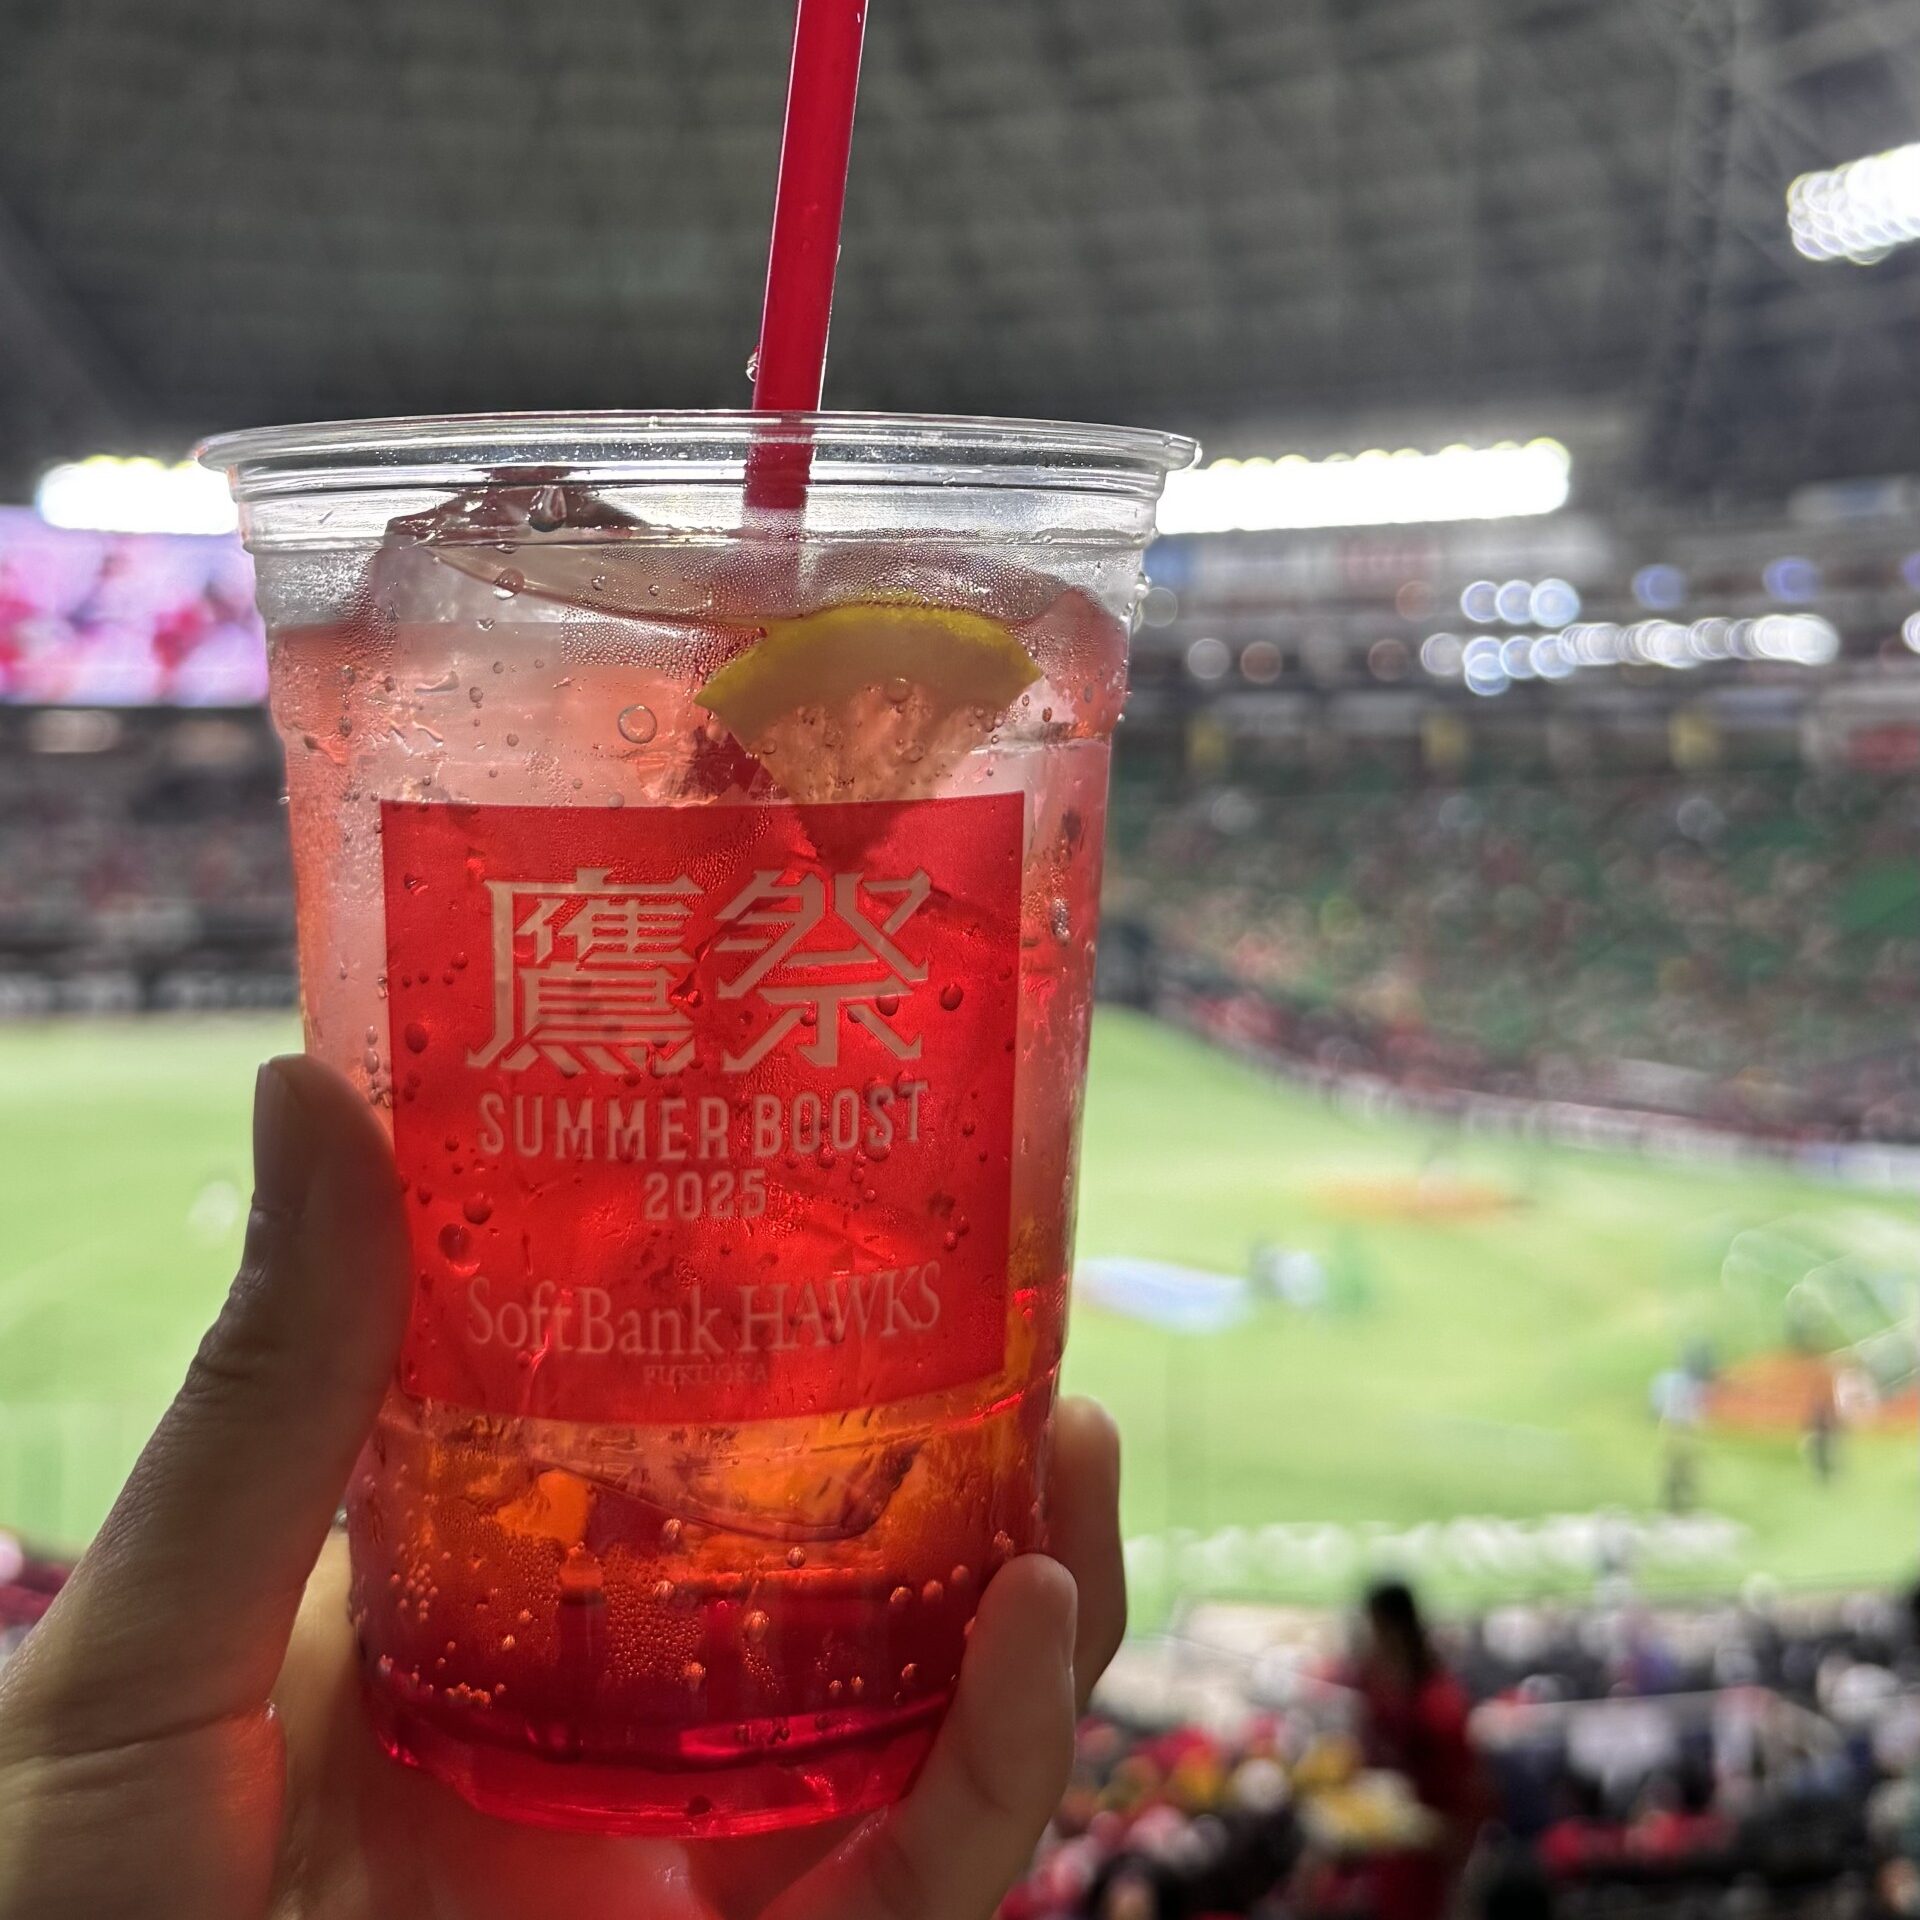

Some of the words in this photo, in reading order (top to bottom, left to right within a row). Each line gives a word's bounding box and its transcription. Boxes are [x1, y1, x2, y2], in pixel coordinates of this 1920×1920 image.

[465, 866, 934, 1077] 鷹祭
[479, 1091, 731, 1162] SUMMER
[753, 1079, 929, 1158] BOOST
[643, 1168, 768, 1222] 2025
[465, 1275, 723, 1357] SoftBank
[738, 1259, 942, 1352] HAWKS
